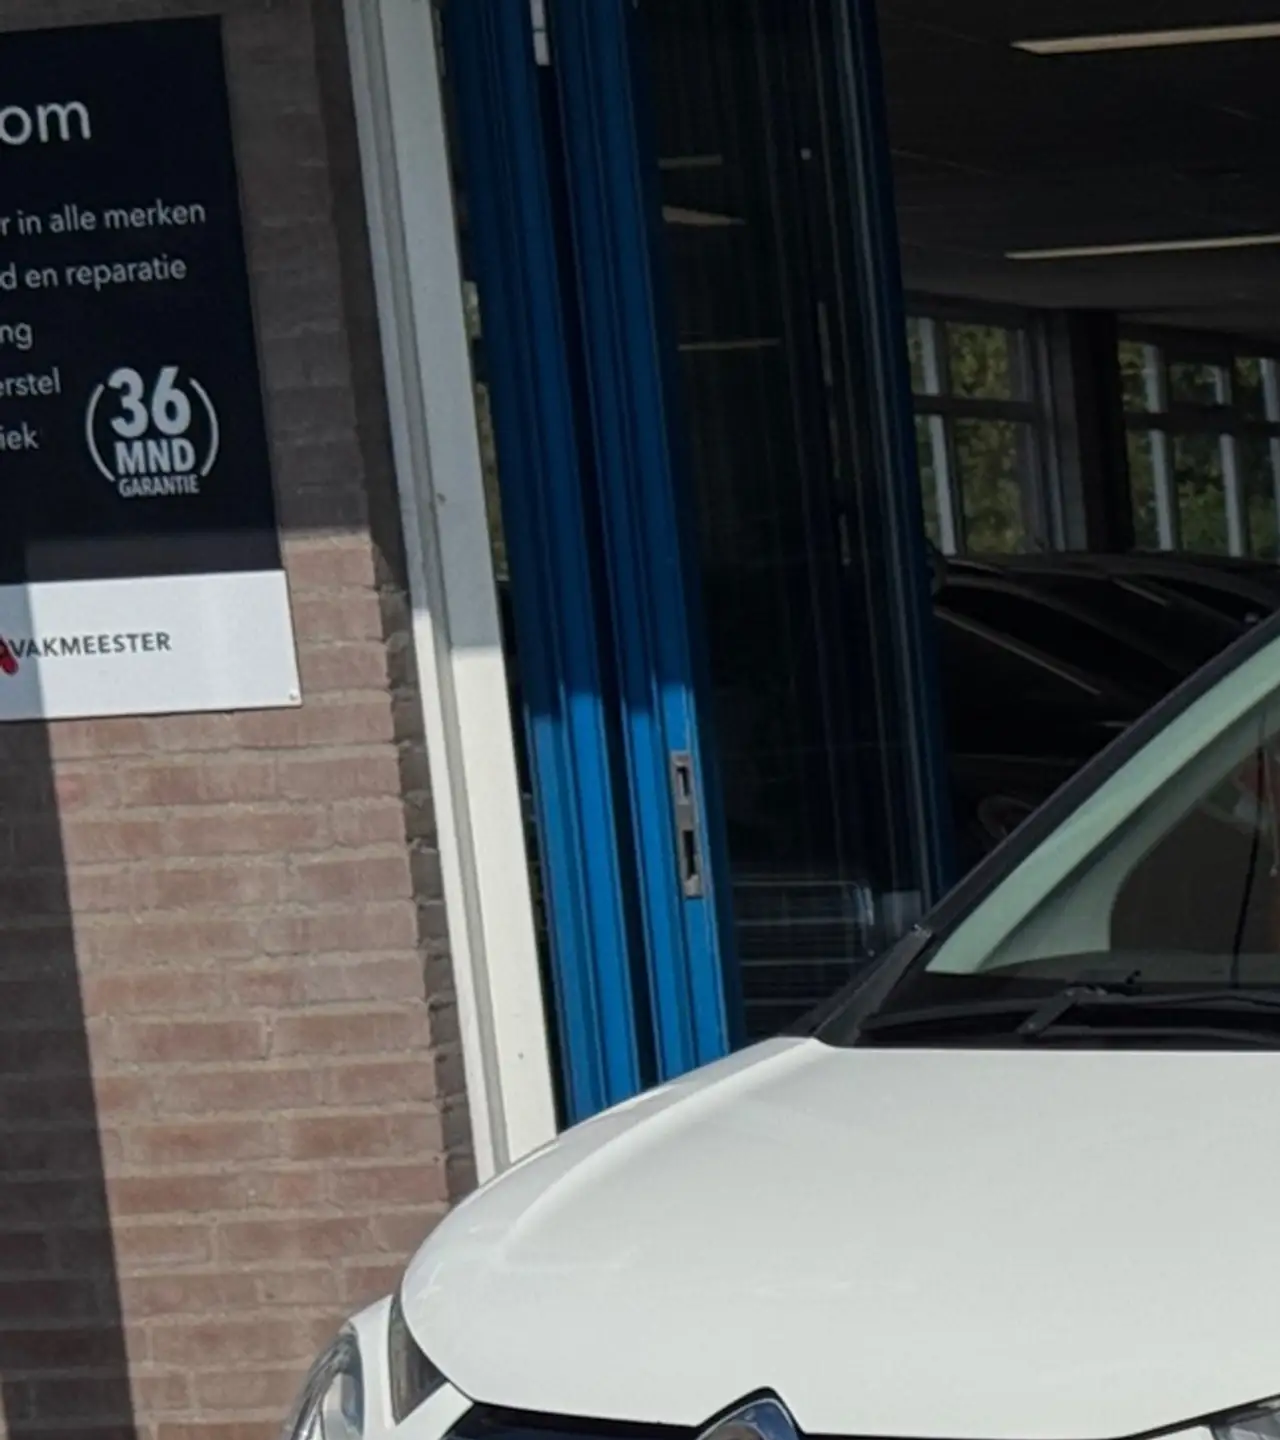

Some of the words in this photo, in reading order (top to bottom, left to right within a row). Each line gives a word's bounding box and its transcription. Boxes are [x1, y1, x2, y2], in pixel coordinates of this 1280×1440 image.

[17, 210, 43, 235] in
[49, 203, 96, 233] alle
[104, 198, 206, 229] merken
[25, 267, 59, 289] en
[66, 253, 187, 292] reparatie
[108, 366, 192, 438] 36
[114, 438, 196, 475] MND
[119, 474, 200, 498] GARANTIE
[7, 632, 172, 659] VAKMEESTER
